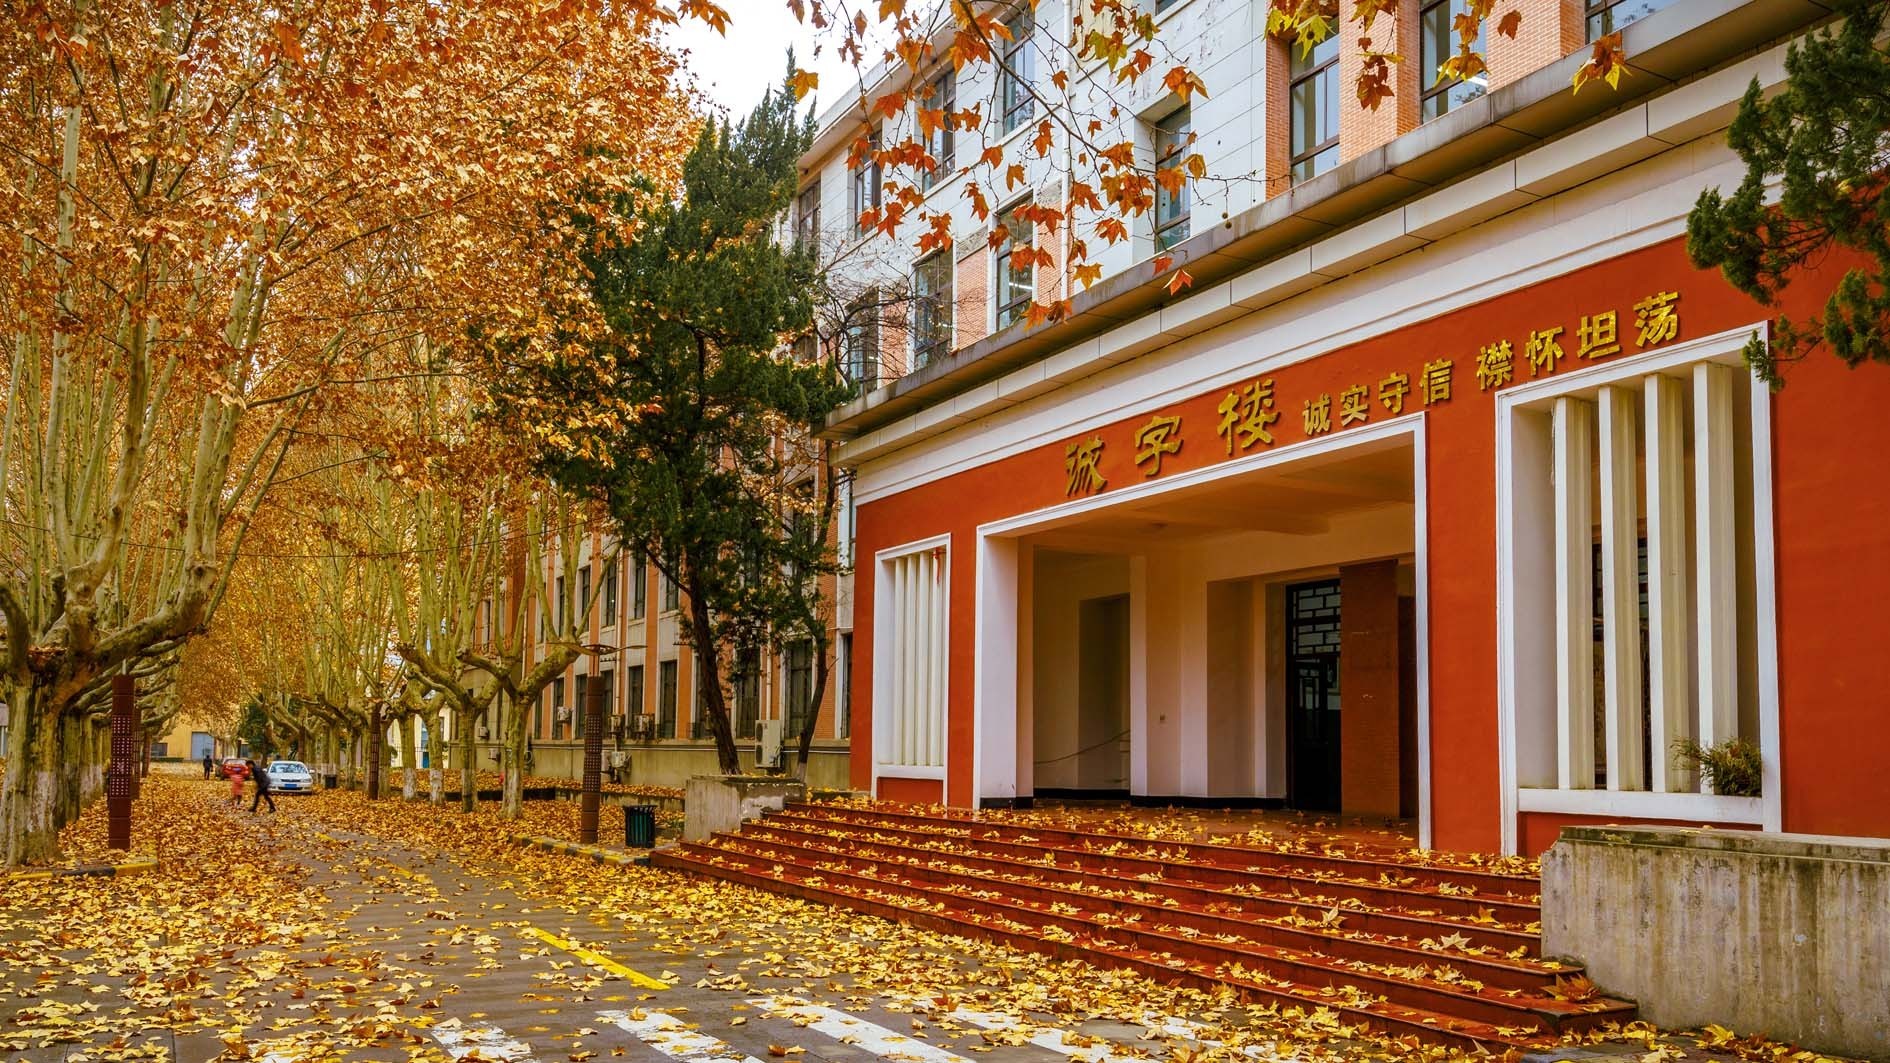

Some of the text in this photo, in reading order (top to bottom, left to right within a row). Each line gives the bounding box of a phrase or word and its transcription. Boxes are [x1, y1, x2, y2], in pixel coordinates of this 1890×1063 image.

[1302, 291, 1679, 435] 诚实守信 襟怀坦荡
[1065, 379, 1279, 496] 诚字楼
